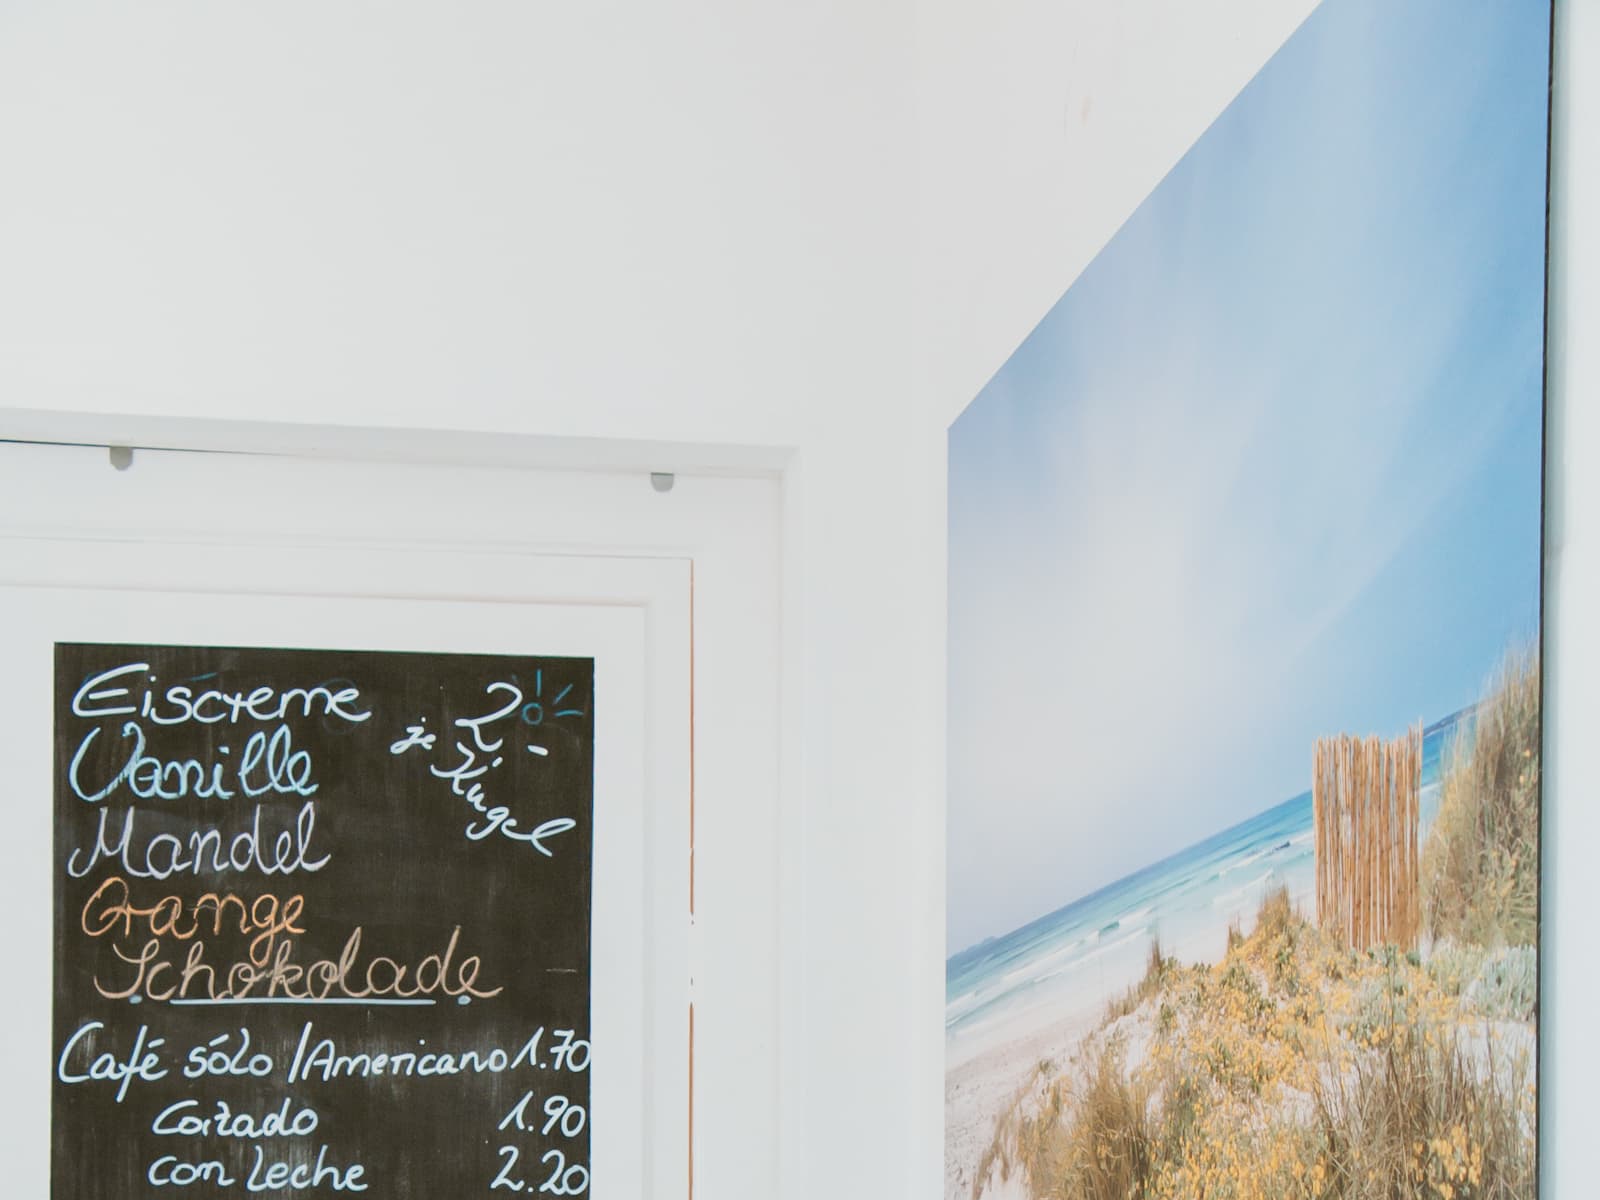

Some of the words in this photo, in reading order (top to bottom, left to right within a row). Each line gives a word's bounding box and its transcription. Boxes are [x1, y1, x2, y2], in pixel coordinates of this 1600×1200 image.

[72, 663, 372, 725] Eiscreme
[68, 722, 319, 802] Vanille
[390, 716, 436, 755] je
[67, 801, 331, 880] Mandel
[81, 876, 306, 968] Orange
[93, 924, 503, 1001] Schokolade
[58, 1021, 168, 1102] Café
[510, 1026, 591, 1073] 1.70
[152, 1097, 318, 1138] Cortado
[498, 1090, 586, 1138] 1.90
[491, 1145, 590, 1196] 2.20
